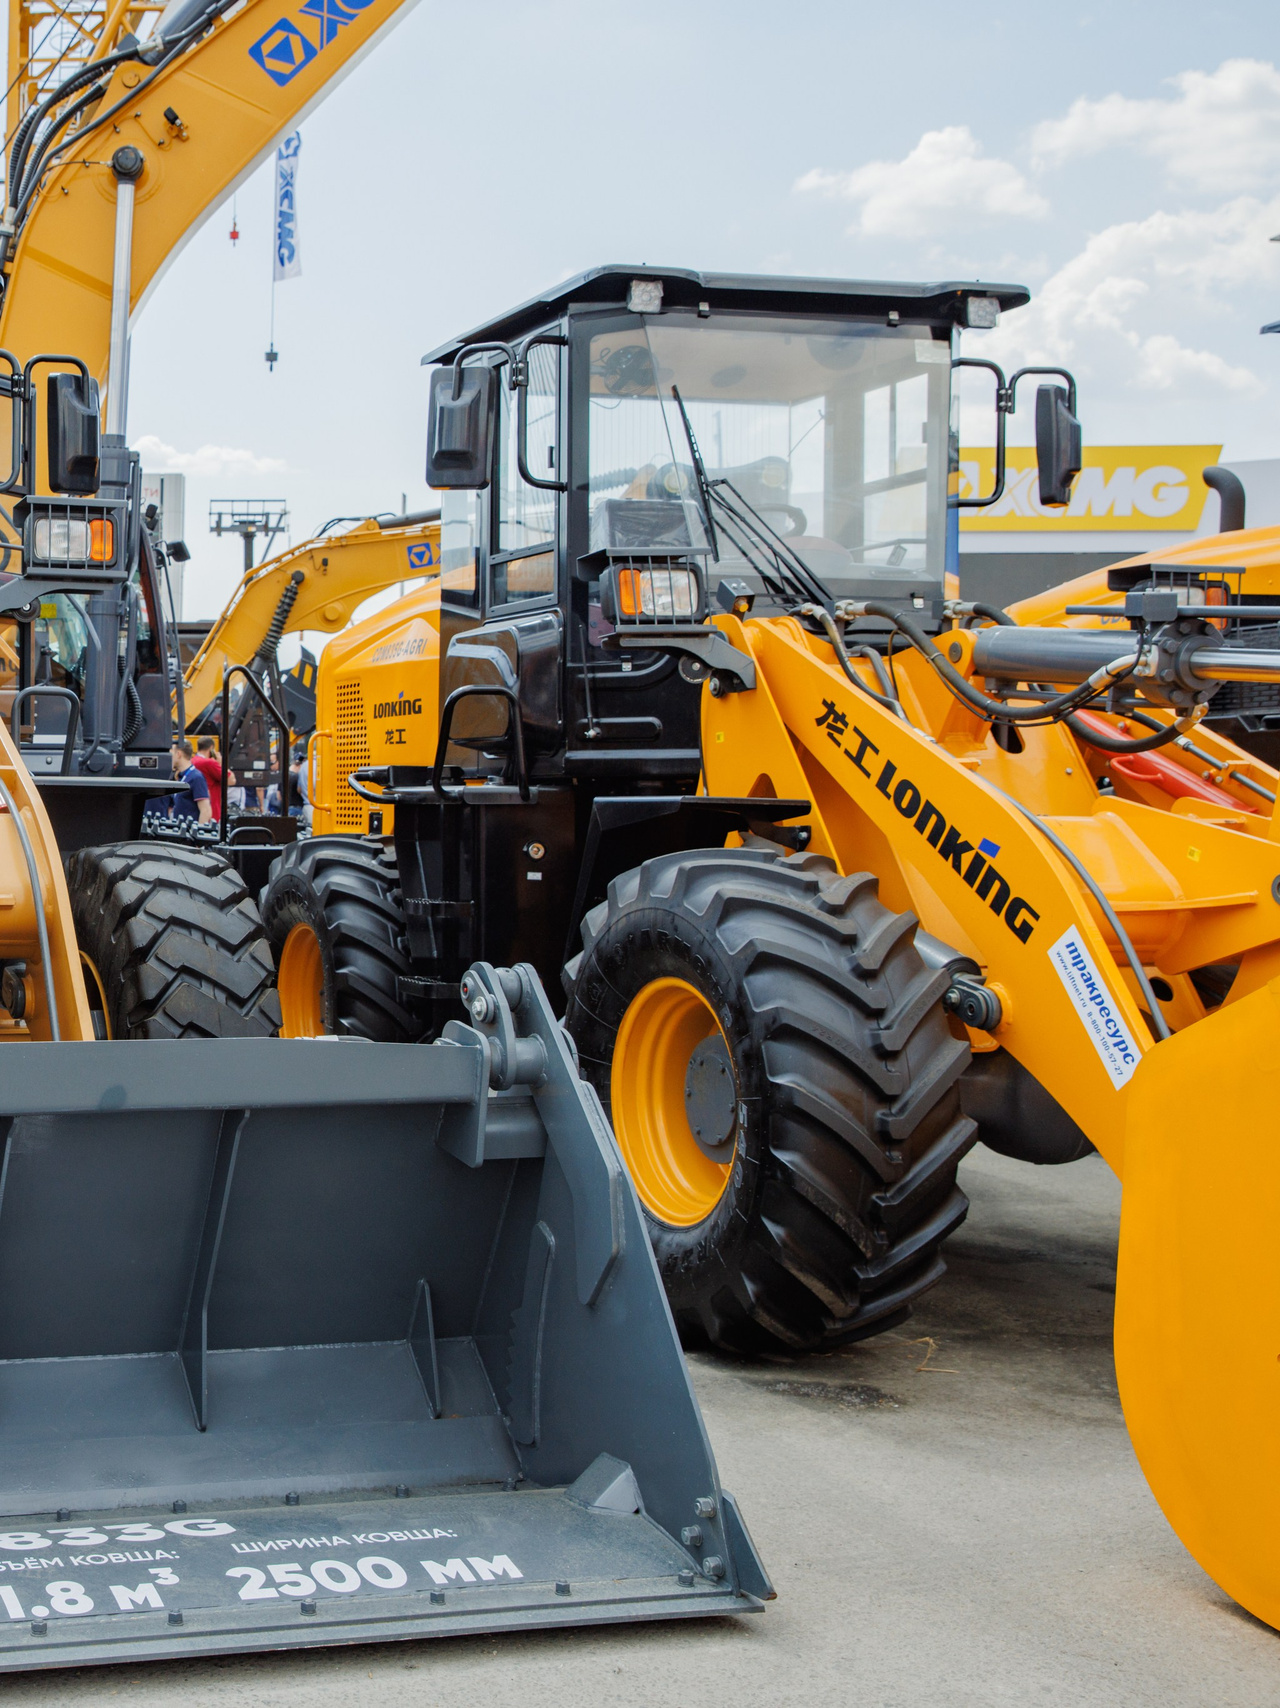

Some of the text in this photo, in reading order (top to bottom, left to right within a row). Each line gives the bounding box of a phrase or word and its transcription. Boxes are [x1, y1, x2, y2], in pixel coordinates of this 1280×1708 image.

[278, 165, 295, 267] XCMG
[373, 691, 422, 719] LONKING
[875, 761, 1040, 945] LONKING
[1065, 941, 1135, 1065] тракресурс
[71, 1549, 180, 1566] КОВША:
[231, 1527, 458, 1553] ШИРИНА КОВША:
[225, 1556, 408, 1600] 2500
